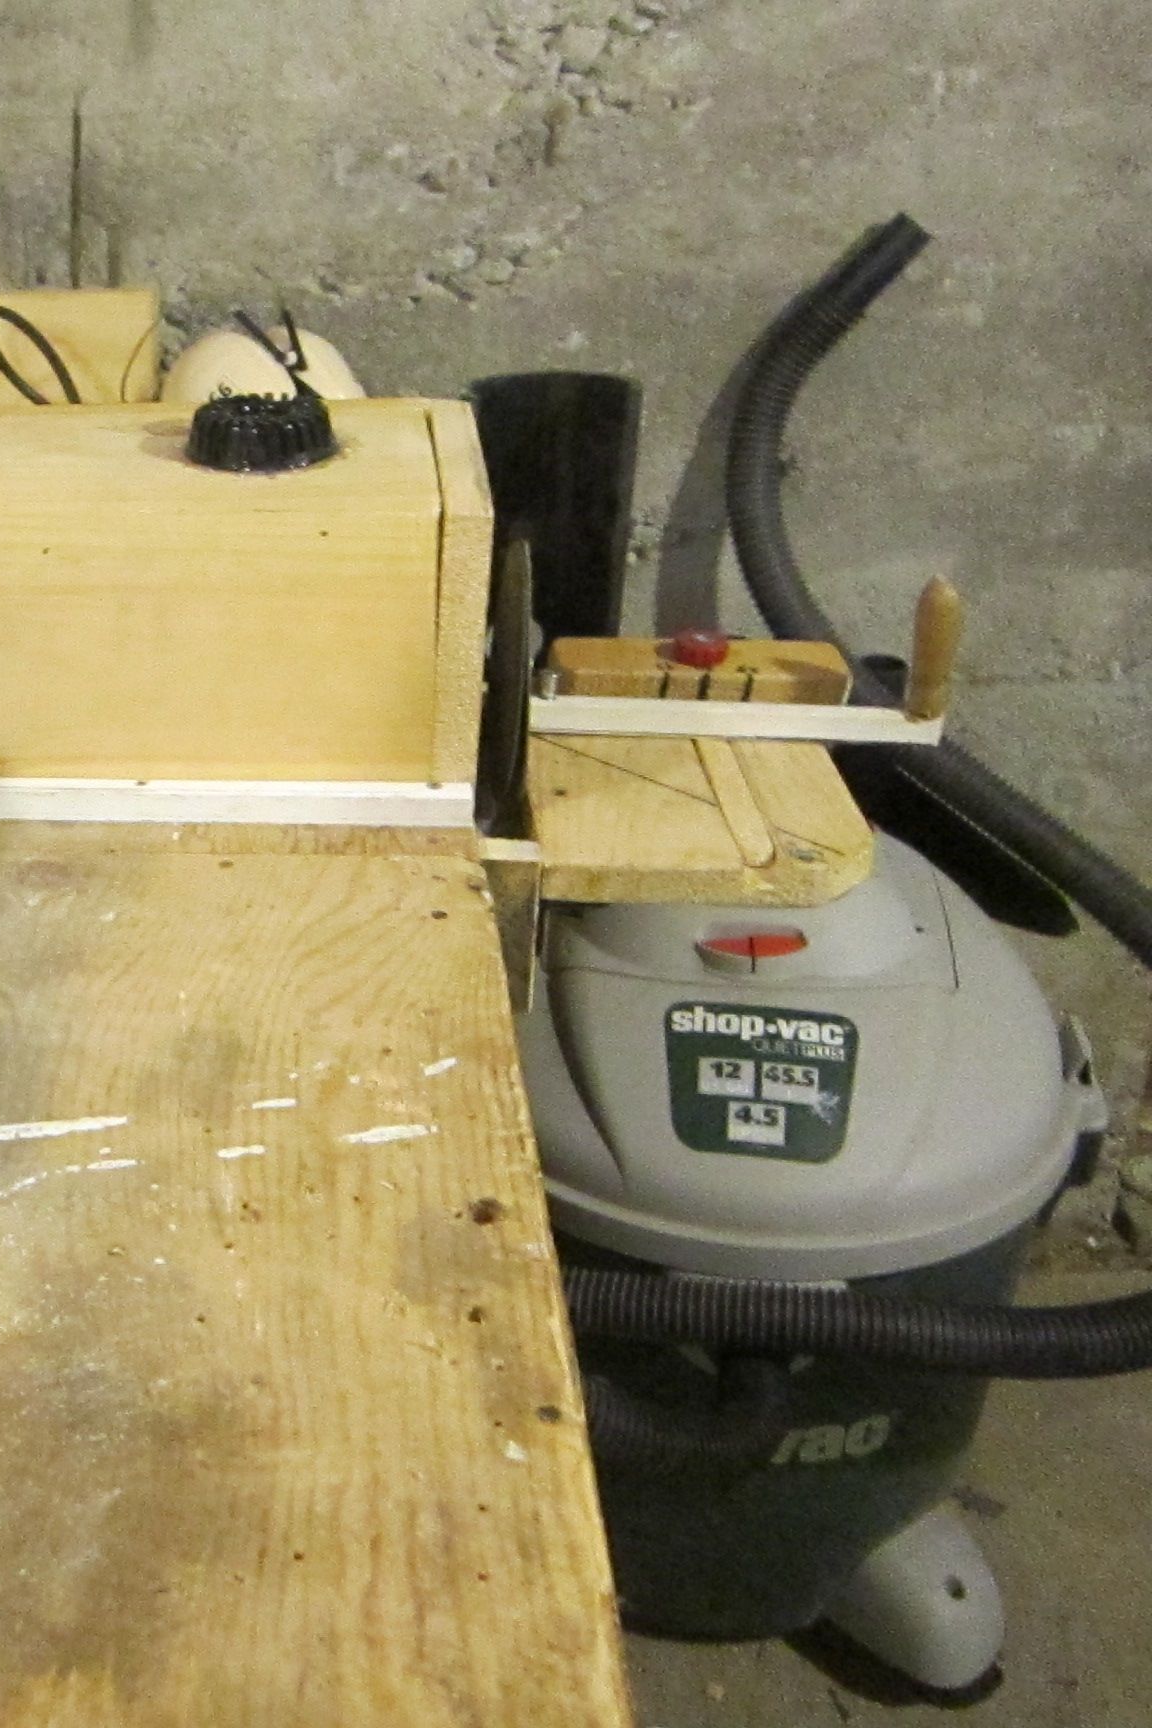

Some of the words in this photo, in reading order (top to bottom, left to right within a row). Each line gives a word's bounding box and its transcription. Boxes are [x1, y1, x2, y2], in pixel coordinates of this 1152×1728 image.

[709, 1062, 741, 1080] 12
[764, 1065, 814, 1086] 45.5
[734, 1105, 778, 1126] 4.5
